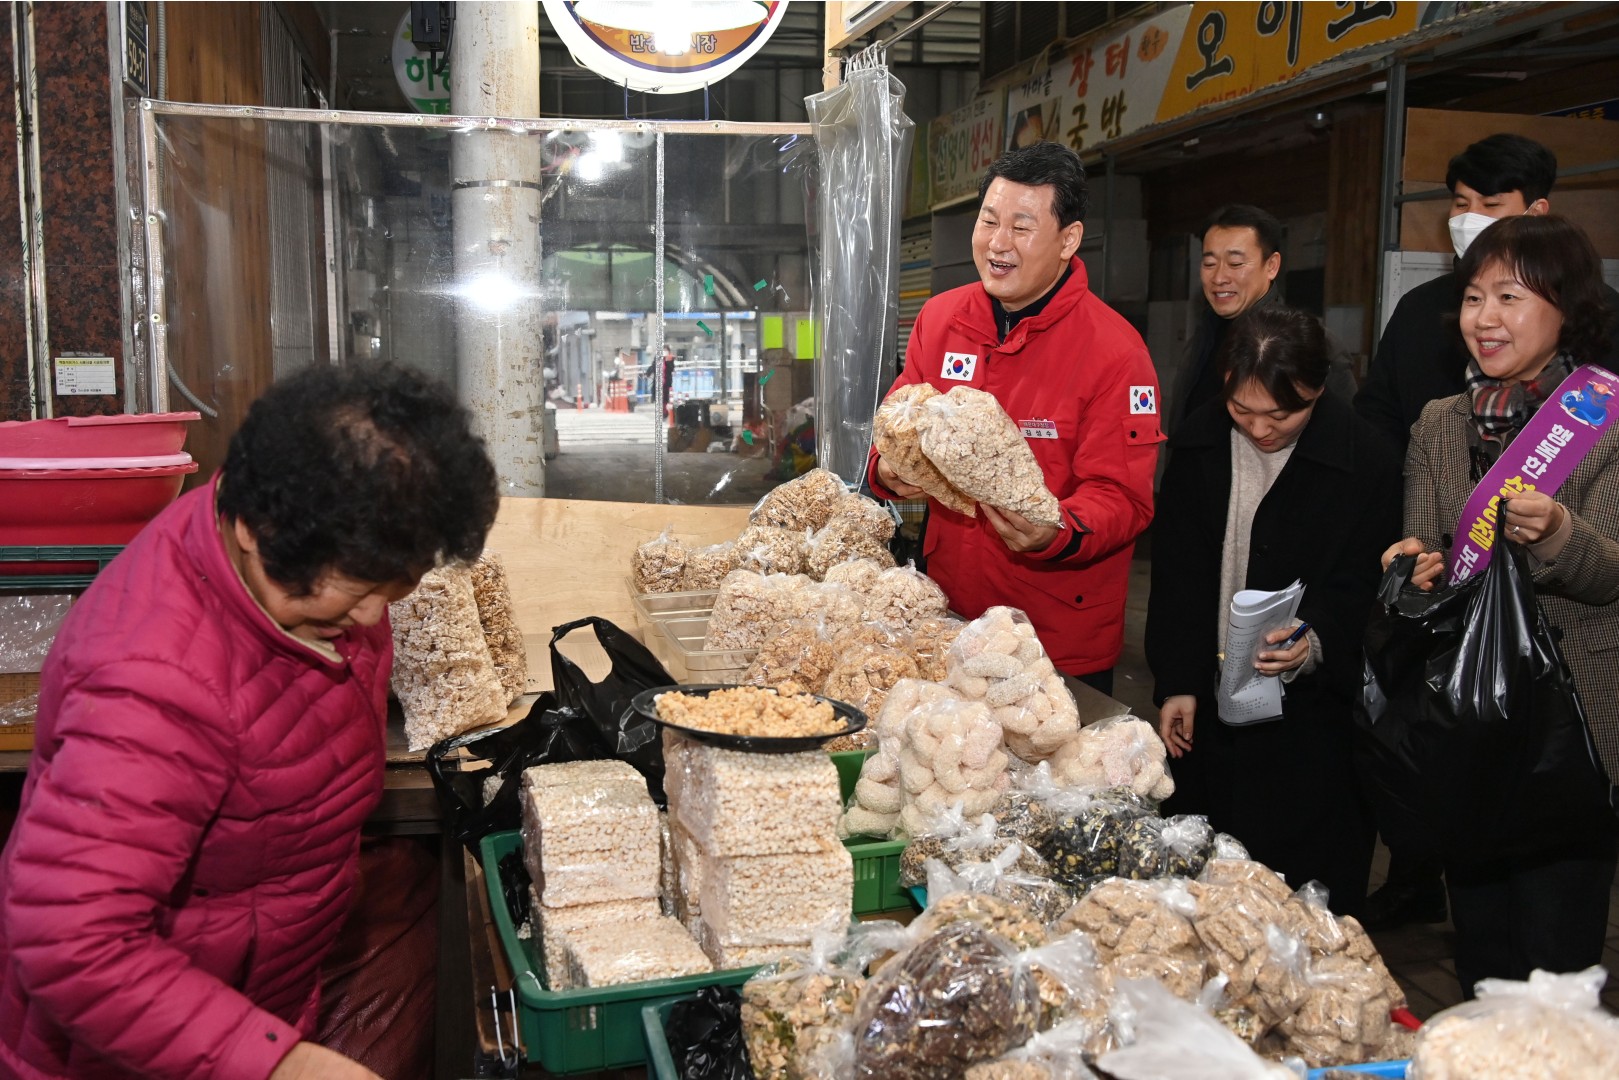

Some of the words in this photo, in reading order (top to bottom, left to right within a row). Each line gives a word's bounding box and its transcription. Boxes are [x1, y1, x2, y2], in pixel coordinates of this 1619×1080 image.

[629, 33, 717, 56] 반송시장
[1068, 35, 1131, 98] 장터
[1521, 423, 1575, 480] 행복한
